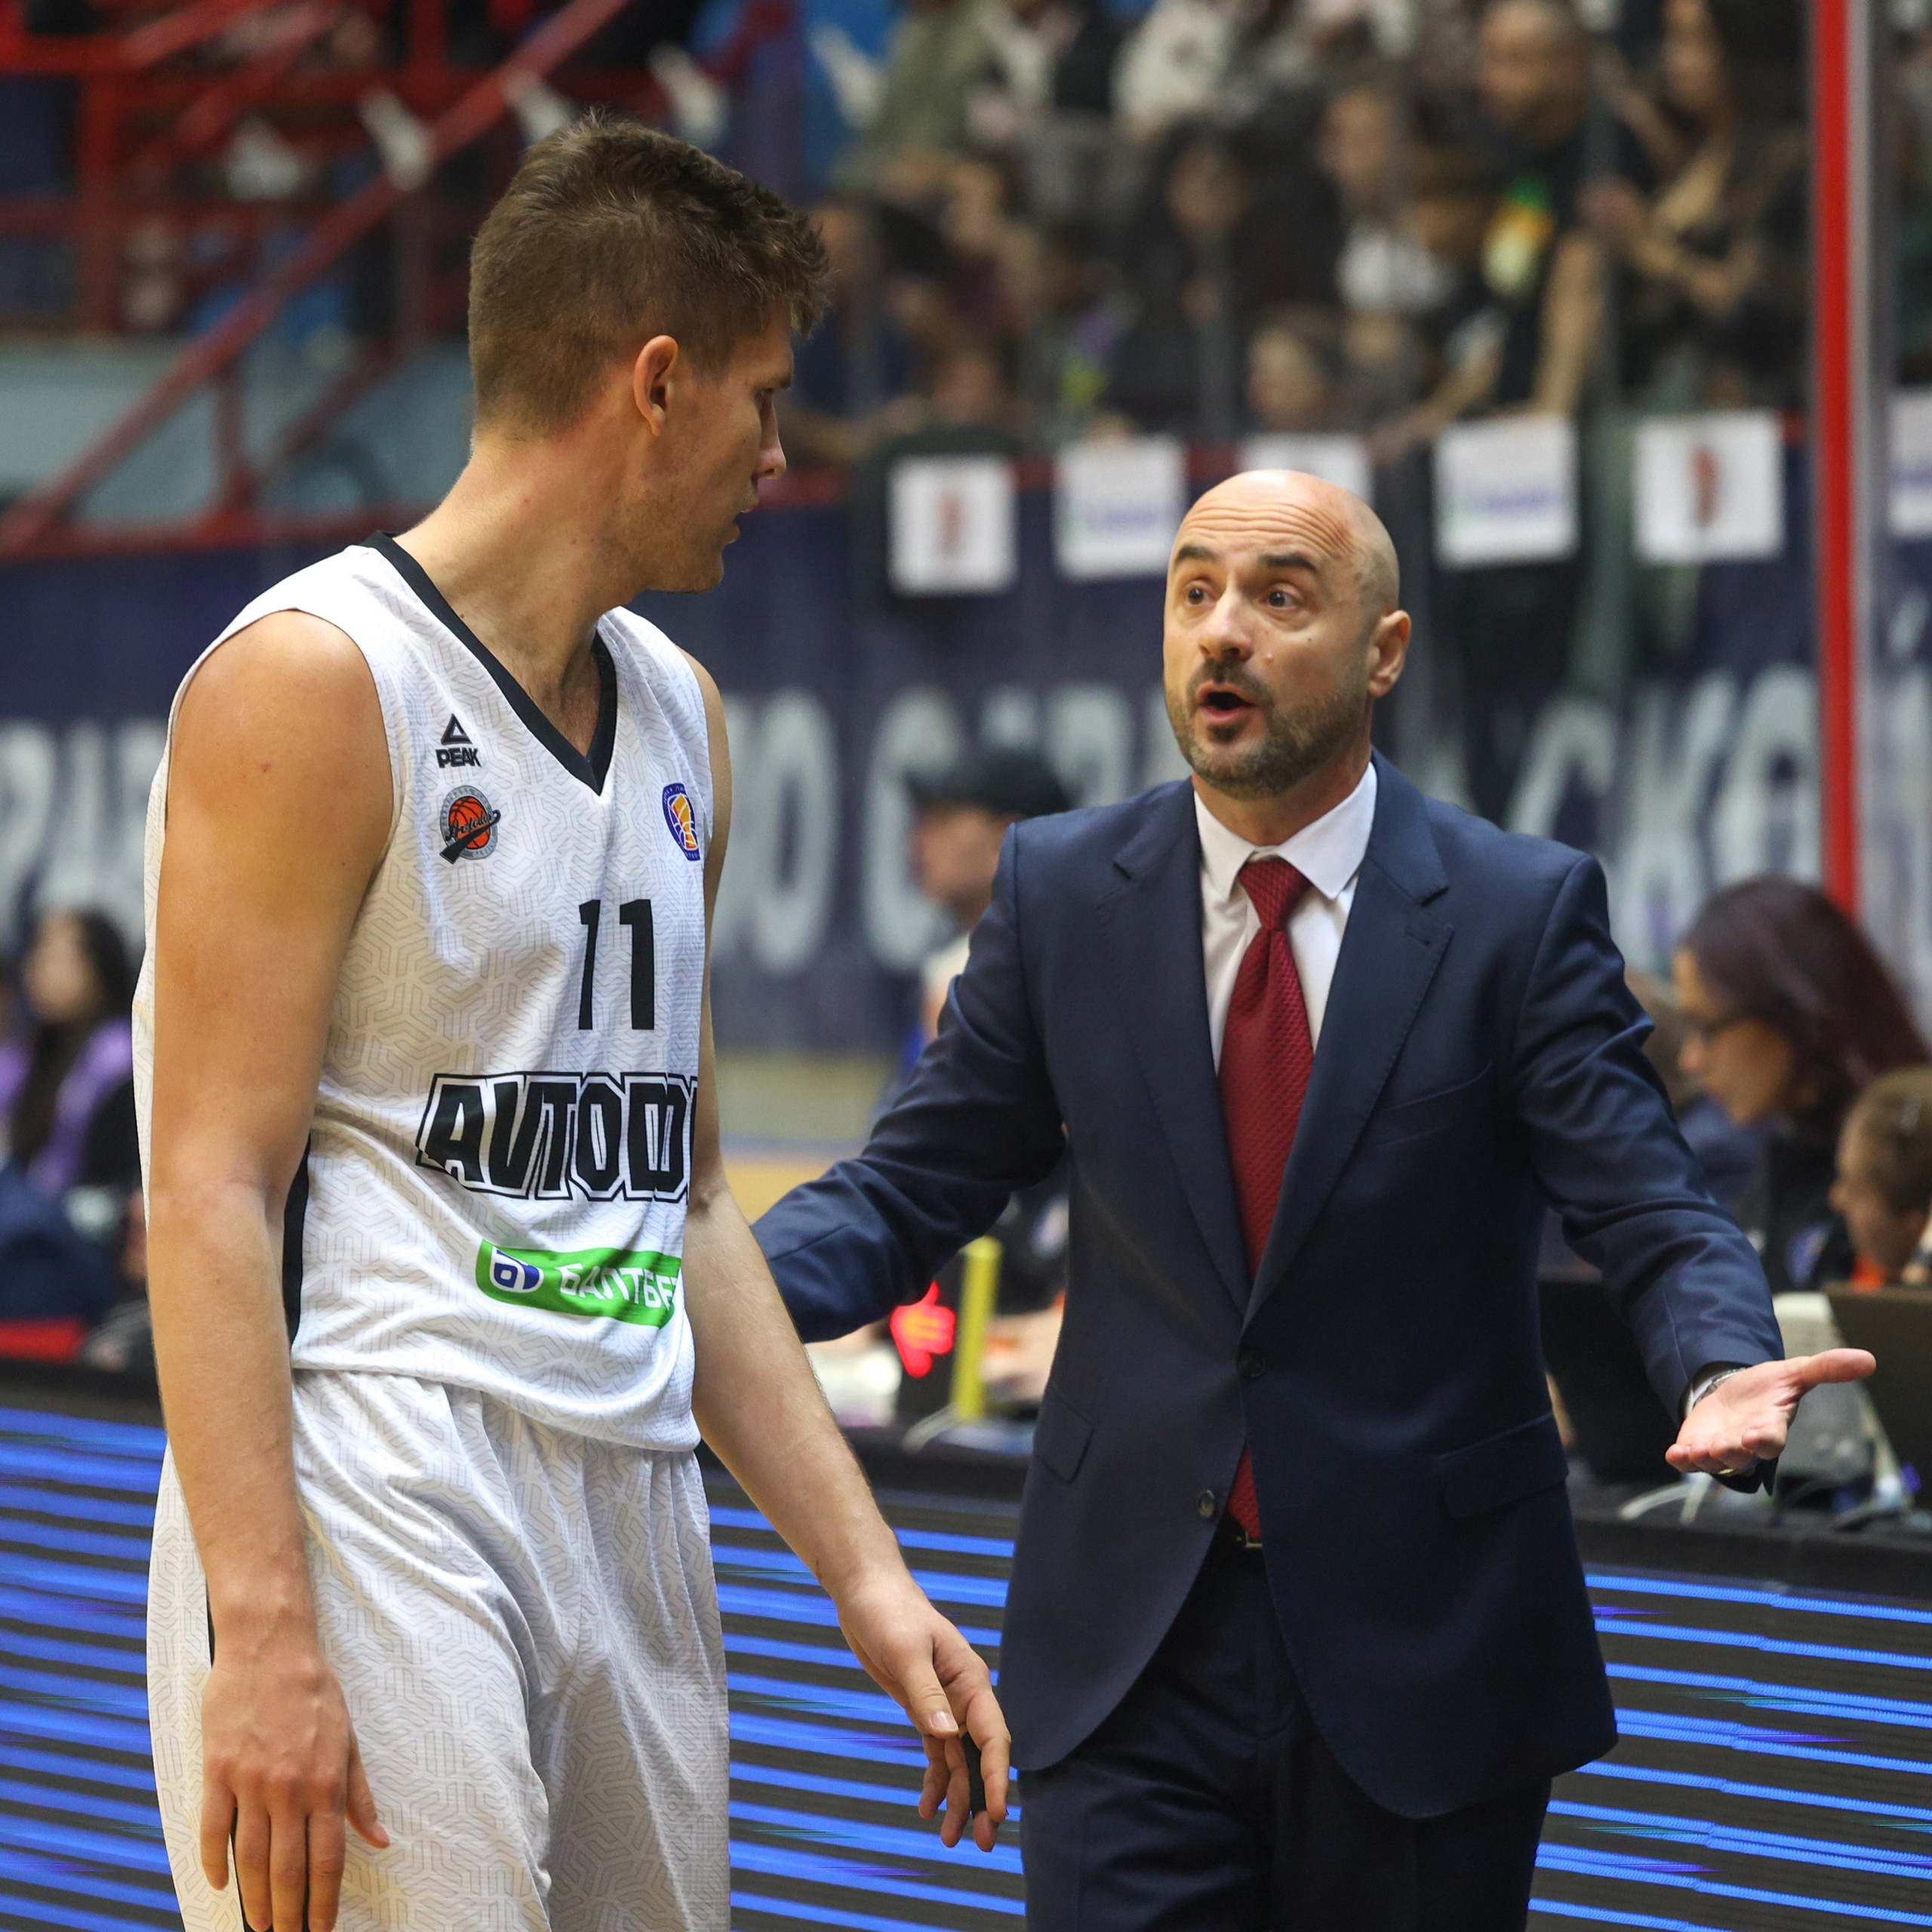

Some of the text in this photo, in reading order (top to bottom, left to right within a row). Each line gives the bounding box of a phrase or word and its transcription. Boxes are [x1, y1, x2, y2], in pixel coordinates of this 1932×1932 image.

[435, 747, 482, 768] PEAK
[578, 899, 655, 1030] 11
[415, 1072, 698, 1205] AVTOD
